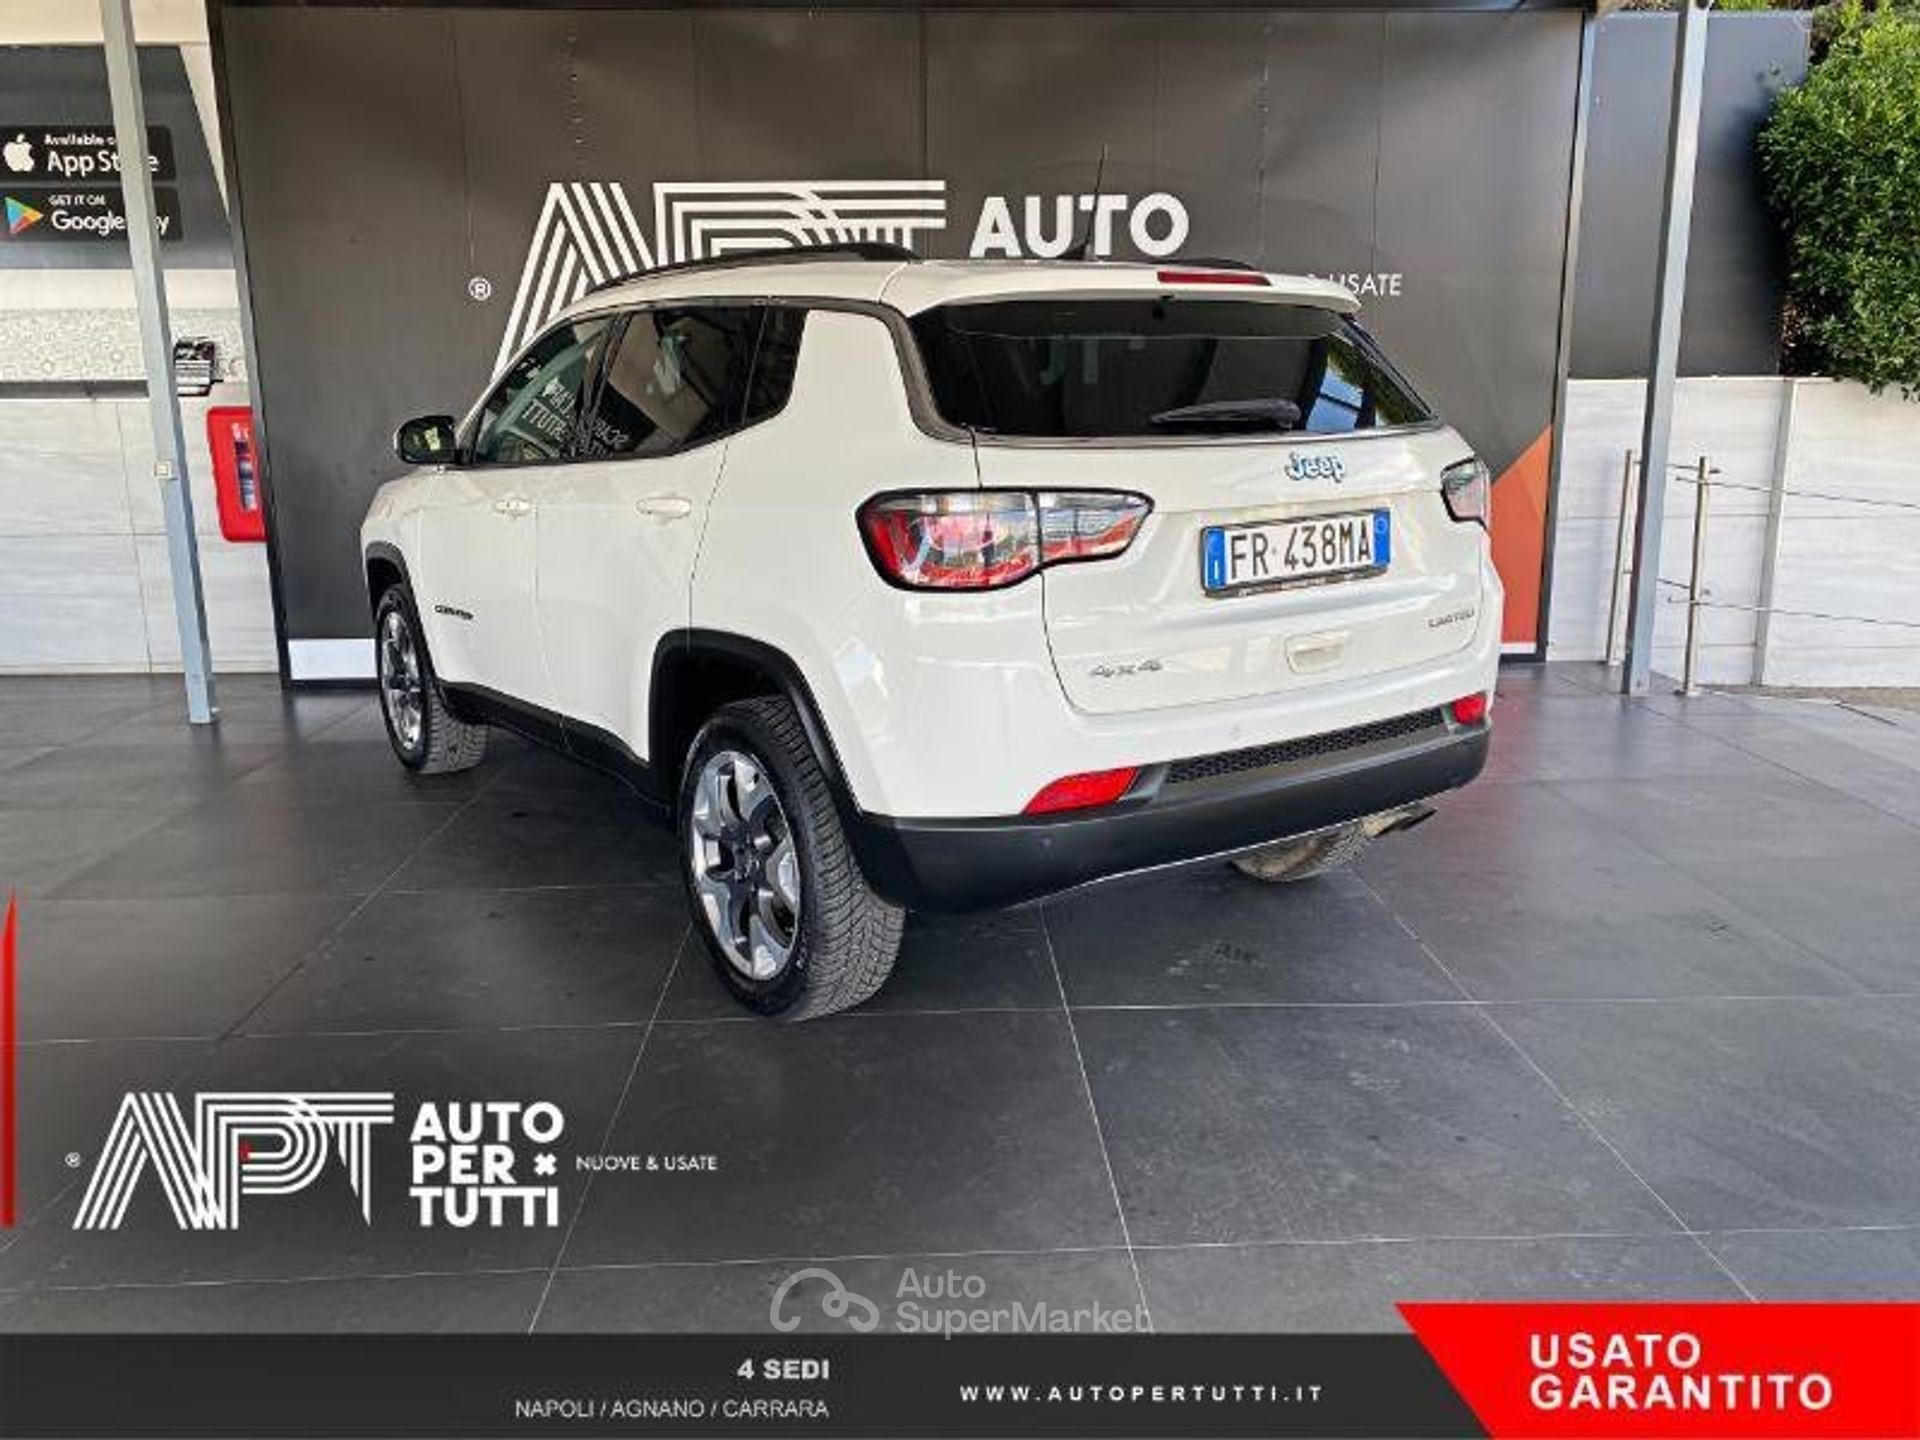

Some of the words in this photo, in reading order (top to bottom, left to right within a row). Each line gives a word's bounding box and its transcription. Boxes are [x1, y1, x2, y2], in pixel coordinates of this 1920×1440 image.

[44, 134, 104, 145] Available
[47, 150, 95, 177] App
[98, 150, 159, 172] Ste
[48, 195, 72, 206] GET
[74, 195, 85, 205] IT
[86, 195, 106, 206] ON
[51, 209, 126, 236] Google
[969, 192, 1190, 258] AUTO
[1285, 452, 1345, 483] Jeep
